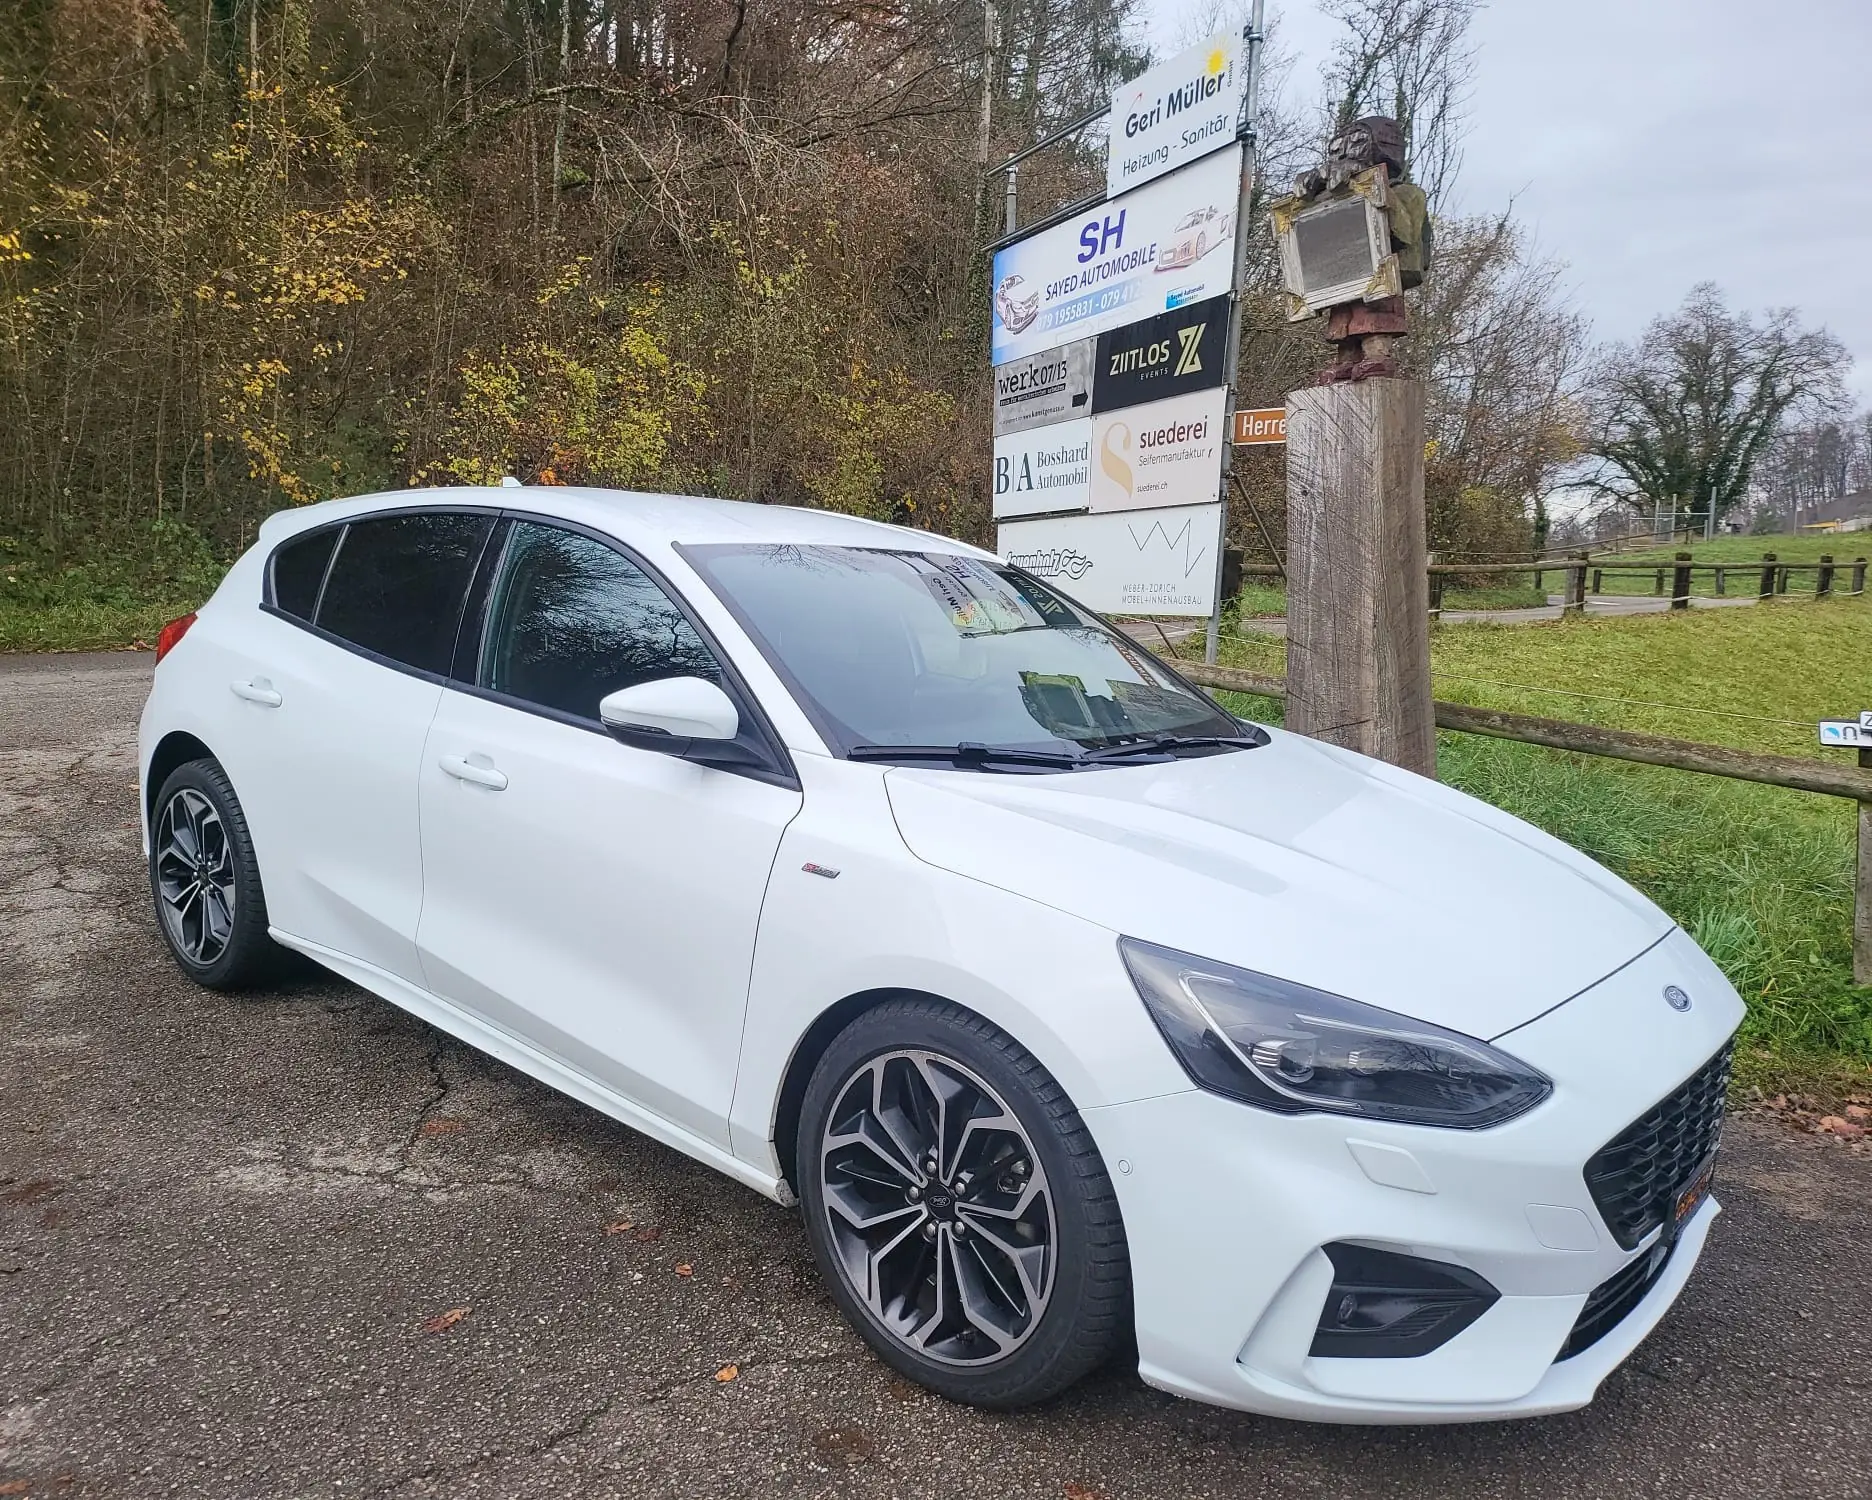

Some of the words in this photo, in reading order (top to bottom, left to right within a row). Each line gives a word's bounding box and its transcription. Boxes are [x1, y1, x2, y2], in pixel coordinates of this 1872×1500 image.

[1125, 99, 1161, 138] Geri
[1166, 72, 1225, 119] Müller
[1123, 146, 1168, 177] Heizung
[1181, 114, 1228, 149] Sanitär
[1077, 208, 1126, 263] SH
[1045, 274, 1078, 300] SAYED
[1079, 243, 1156, 288] AUTOMOBILE
[1055, 298, 1093, 325] 1955831
[1101, 289, 1120, 309] 079
[1109, 340, 1170, 376] ZIITLOS
[1140, 367, 1169, 381] EVENTS
[999, 363, 1039, 395] werk
[1139, 415, 1208, 449] suederei
[1242, 415, 1286, 437] Herre
[1037, 442, 1088, 468] Bosshard
[1138, 448, 1205, 467] Seifenmanufaktur
[1036, 467, 1088, 490] Automobil
[1137, 481, 1168, 493] suederei.ch
